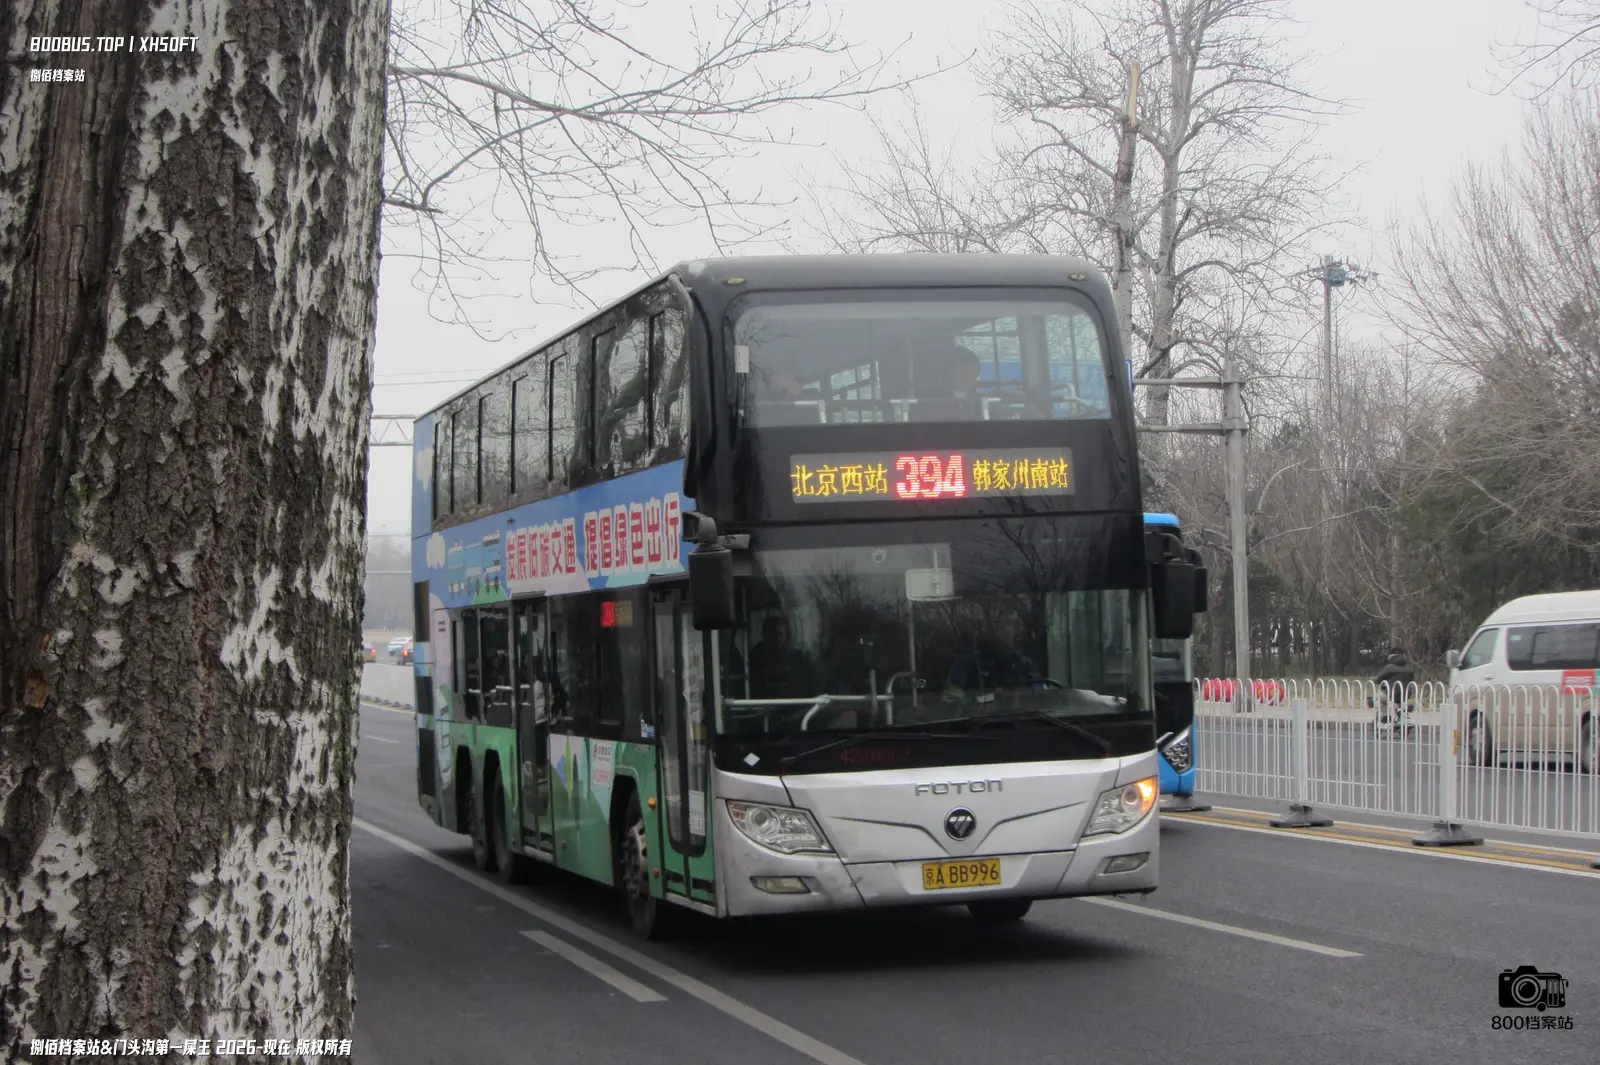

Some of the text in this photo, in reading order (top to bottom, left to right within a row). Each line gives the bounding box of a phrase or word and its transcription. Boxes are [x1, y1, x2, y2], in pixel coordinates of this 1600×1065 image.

[790, 455, 1068, 499] 北京西站 394 韩家川南站
[506, 500, 680, 582] 发展低碳交通 提倡绿色出行
[915, 778, 1003, 796] FOTON
